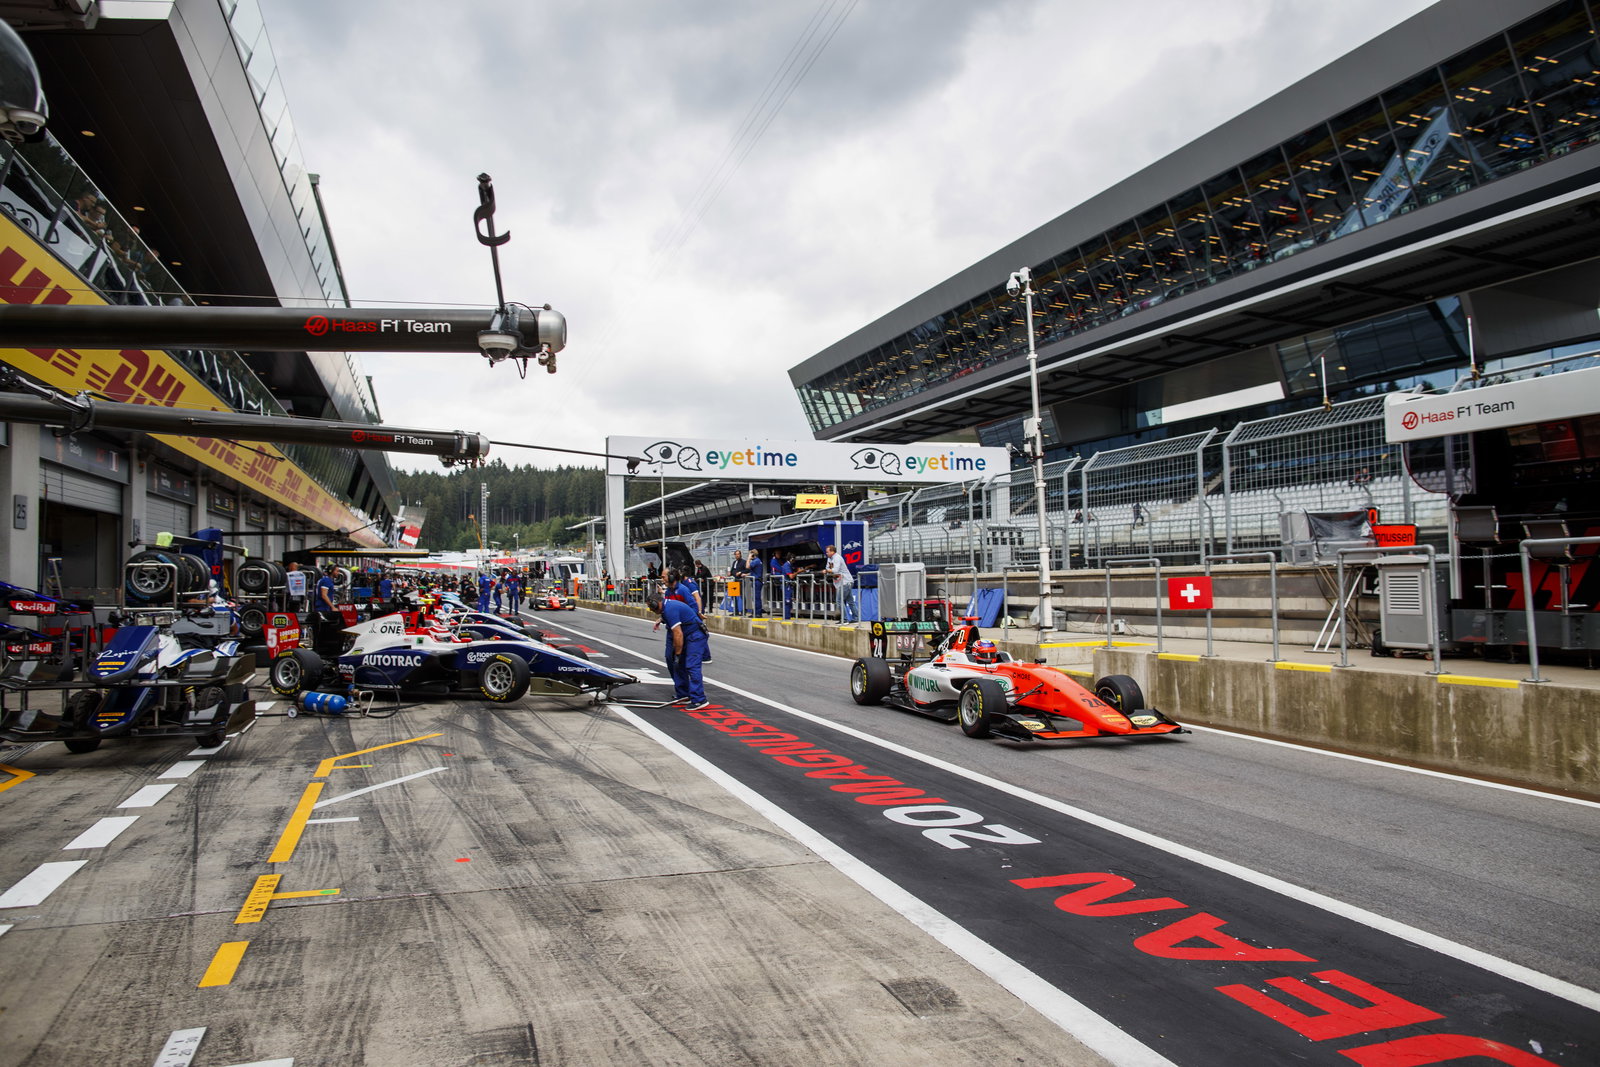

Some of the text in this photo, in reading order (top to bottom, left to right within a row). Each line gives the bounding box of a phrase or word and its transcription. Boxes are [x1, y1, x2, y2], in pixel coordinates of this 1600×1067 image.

[332, 319, 452, 333] Haas F1 Team
[1420, 400, 1515, 424] Haas F1 Team
[367, 432, 434, 446] Haas F1 Team
[705, 445, 798, 470] eyetime
[905, 451, 987, 474] eyetime
[16, 504, 27, 520] 25
[843, 551, 862, 565] 10
[15, 602, 56, 612] Red Bull
[380, 625, 402, 634] ONE
[894, 621, 935, 631] WIURI
[266, 627, 278, 649] 5
[873, 638, 884, 659] 24
[361, 654, 422, 667] AUTOTRAC
[913, 676, 941, 693] WIHURI
[1080, 697, 1108, 709] 24
[882, 804, 1043, 851] 20
